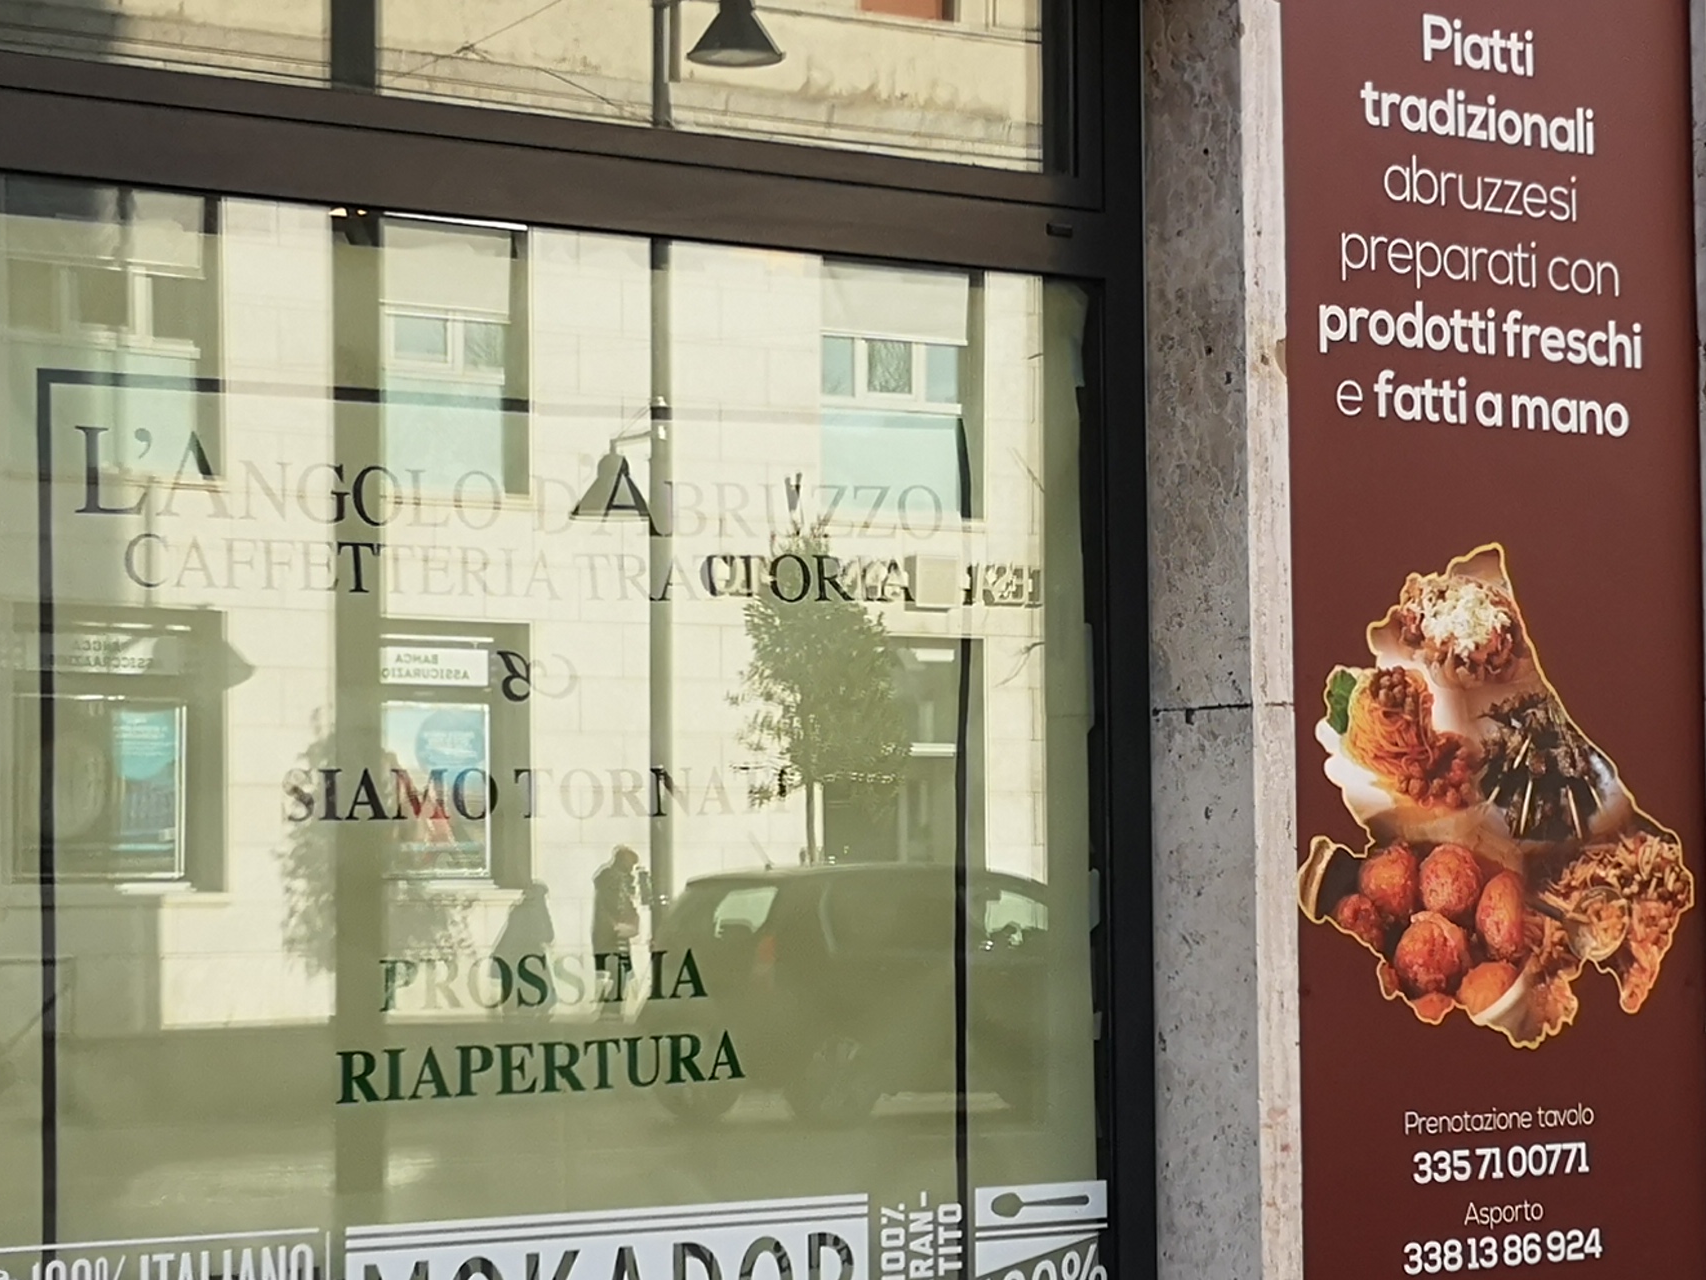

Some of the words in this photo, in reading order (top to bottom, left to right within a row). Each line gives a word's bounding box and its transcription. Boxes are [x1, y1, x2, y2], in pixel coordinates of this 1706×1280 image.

[1423, 14, 1534, 76] Piatti
[1361, 82, 1594, 154] tradizionali
[1384, 155, 1577, 221] abruzzesi
[1341, 232, 1537, 289] preparati
[1548, 256, 1619, 296] con
[1319, 301, 1496, 356] prodotti
[1503, 310, 1642, 369] freschi
[1337, 379, 1363, 415] e
[1374, 370, 1467, 424] fatti
[1475, 389, 1502, 427] a
[1512, 392, 1629, 436] mano
[124, 533, 562, 602] CAFFETTERIA
[285, 768, 497, 823] SIAMO
[379, 948, 708, 1014] PROSSIMA
[336, 1030, 745, 1106] RIAPERTURA
[1405, 1107, 1532, 1135] Prenotazione
[1537, 1103, 1594, 1127] tavolo
[1413, 1149, 1471, 1183] 335
[938, 1202, 963, 1276] TITO
[1464, 1200, 1543, 1229] Asporto
[1403, 1239, 1463, 1275] 338
[1467, 1236, 1498, 1269] 13
[1503, 1233, 1542, 1266] 86
[1546, 1228, 1602, 1262] 924
